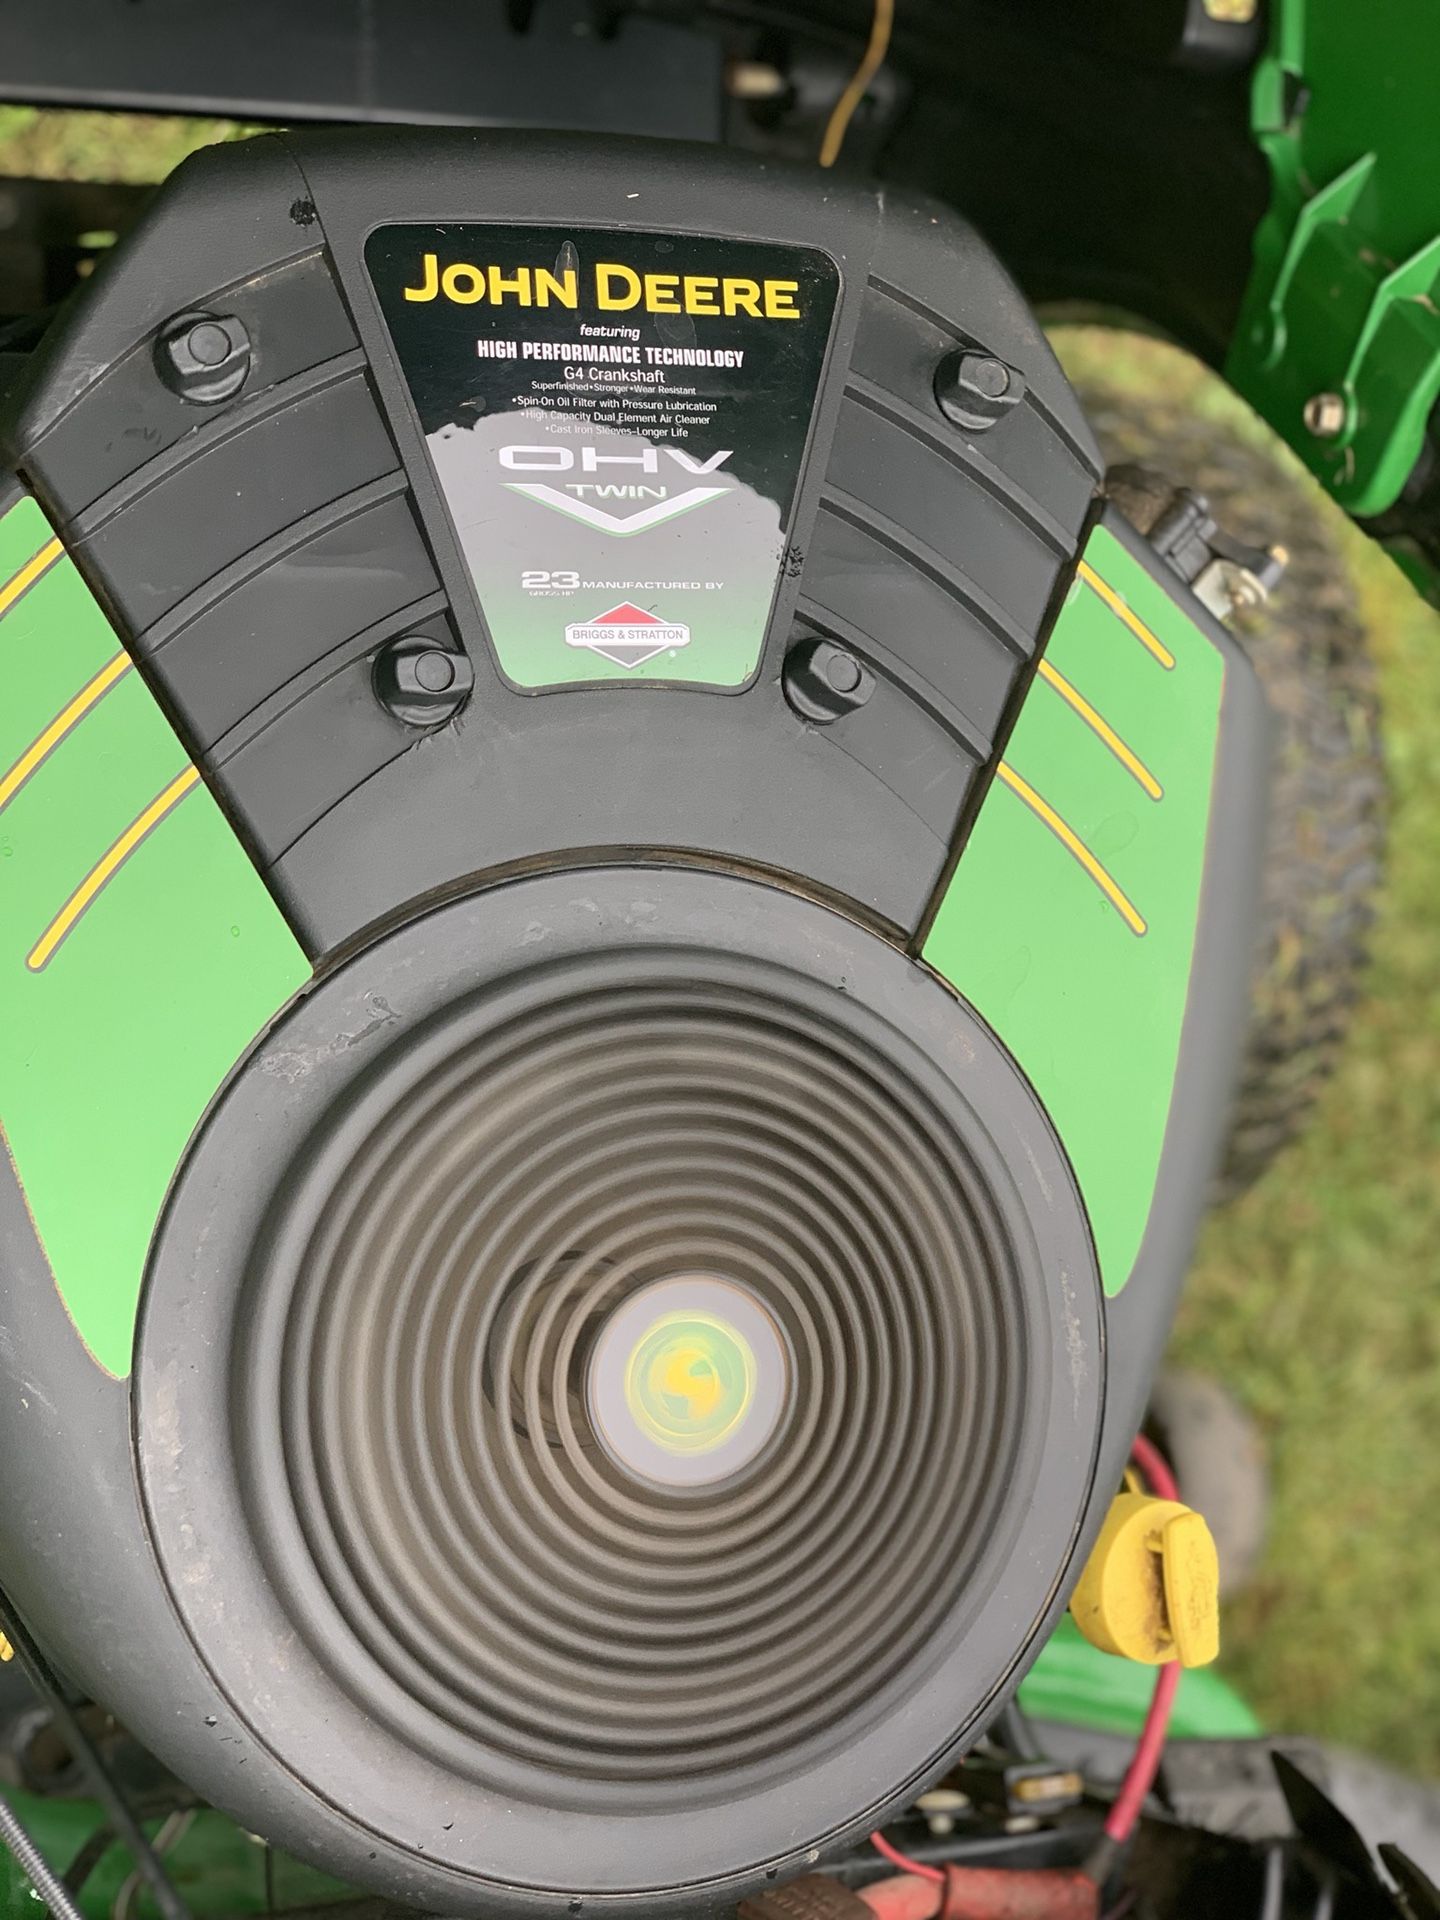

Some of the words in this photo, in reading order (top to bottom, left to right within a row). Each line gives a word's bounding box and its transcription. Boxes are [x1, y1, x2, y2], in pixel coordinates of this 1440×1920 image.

[404, 253, 578, 309] JOHN
[595, 263, 801, 319] DEERE
[580, 323, 640, 341] featuring
[477, 340, 518, 359] HIGH
[522, 341, 641, 365] PERFORMANCE
[645, 347, 744, 368] TECHNOLOGY
[564, 366, 584, 380] G4
[588, 367, 666, 383] Crankshaft
[658, 385, 697, 395] Resistant
[557, 397, 570, 407] Oil
[573, 397, 597, 408] Filter
[599, 398, 620, 409] with
[622, 400, 663, 410] Pressure
[665, 401, 717, 412] Lubrication
[550, 411, 591, 422] Capacity
[593, 412, 615, 422] Dual
[618, 412, 657, 423] Element
[660, 414, 672, 423] Air
[675, 414, 711, 425] Cleaner
[574, 424, 593, 434] Iron
[671, 428, 689, 438] Life
[499, 445, 734, 475] OHV
[565, 484, 667, 499] TWIN
[521, 571, 580, 589] 23
[582, 581, 701, 591] MANUFACTURED
[705, 582, 724, 591] BY
[572, 629, 615, 640] BRIGGS
[618, 630, 625, 640] &
[627, 630, 683, 640] STRATTON
